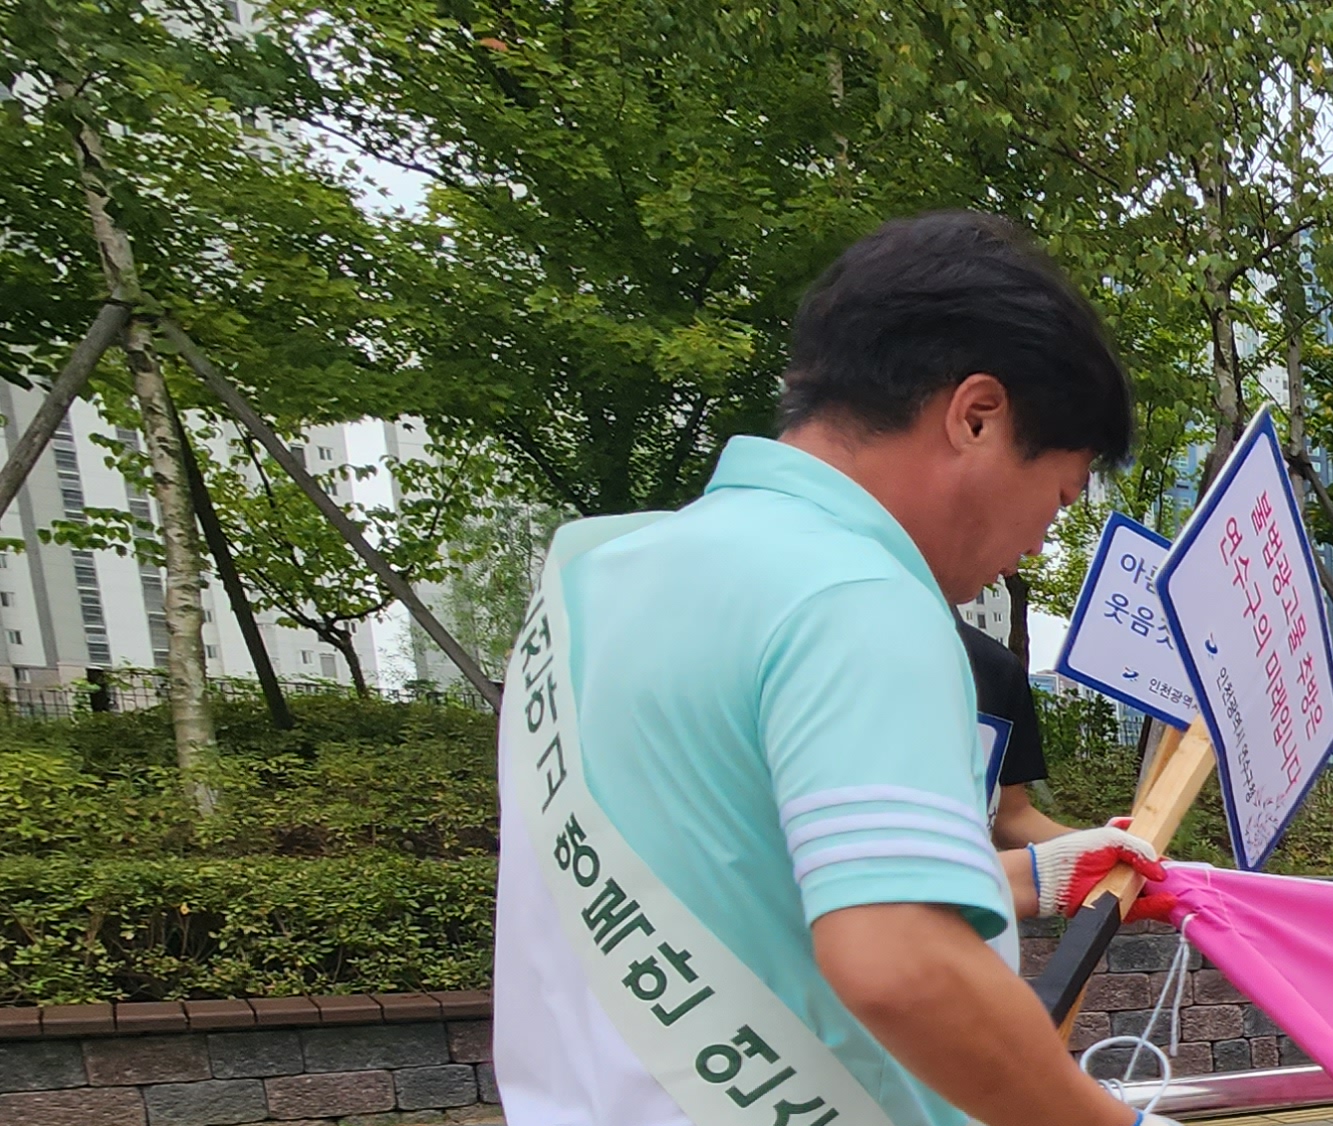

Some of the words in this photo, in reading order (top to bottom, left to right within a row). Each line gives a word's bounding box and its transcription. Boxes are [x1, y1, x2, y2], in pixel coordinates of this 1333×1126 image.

[1219, 516, 1272, 657] 연수구의
[1265, 650, 1302, 794] 미래입니다
[1251, 489, 1307, 656] 불법광고물
[1296, 652, 1323, 741] 추방은
[1216, 667, 1245, 748] 인천광역시
[1238, 743, 1257, 803] 연수구청
[553, 811, 716, 1027] 행복한
